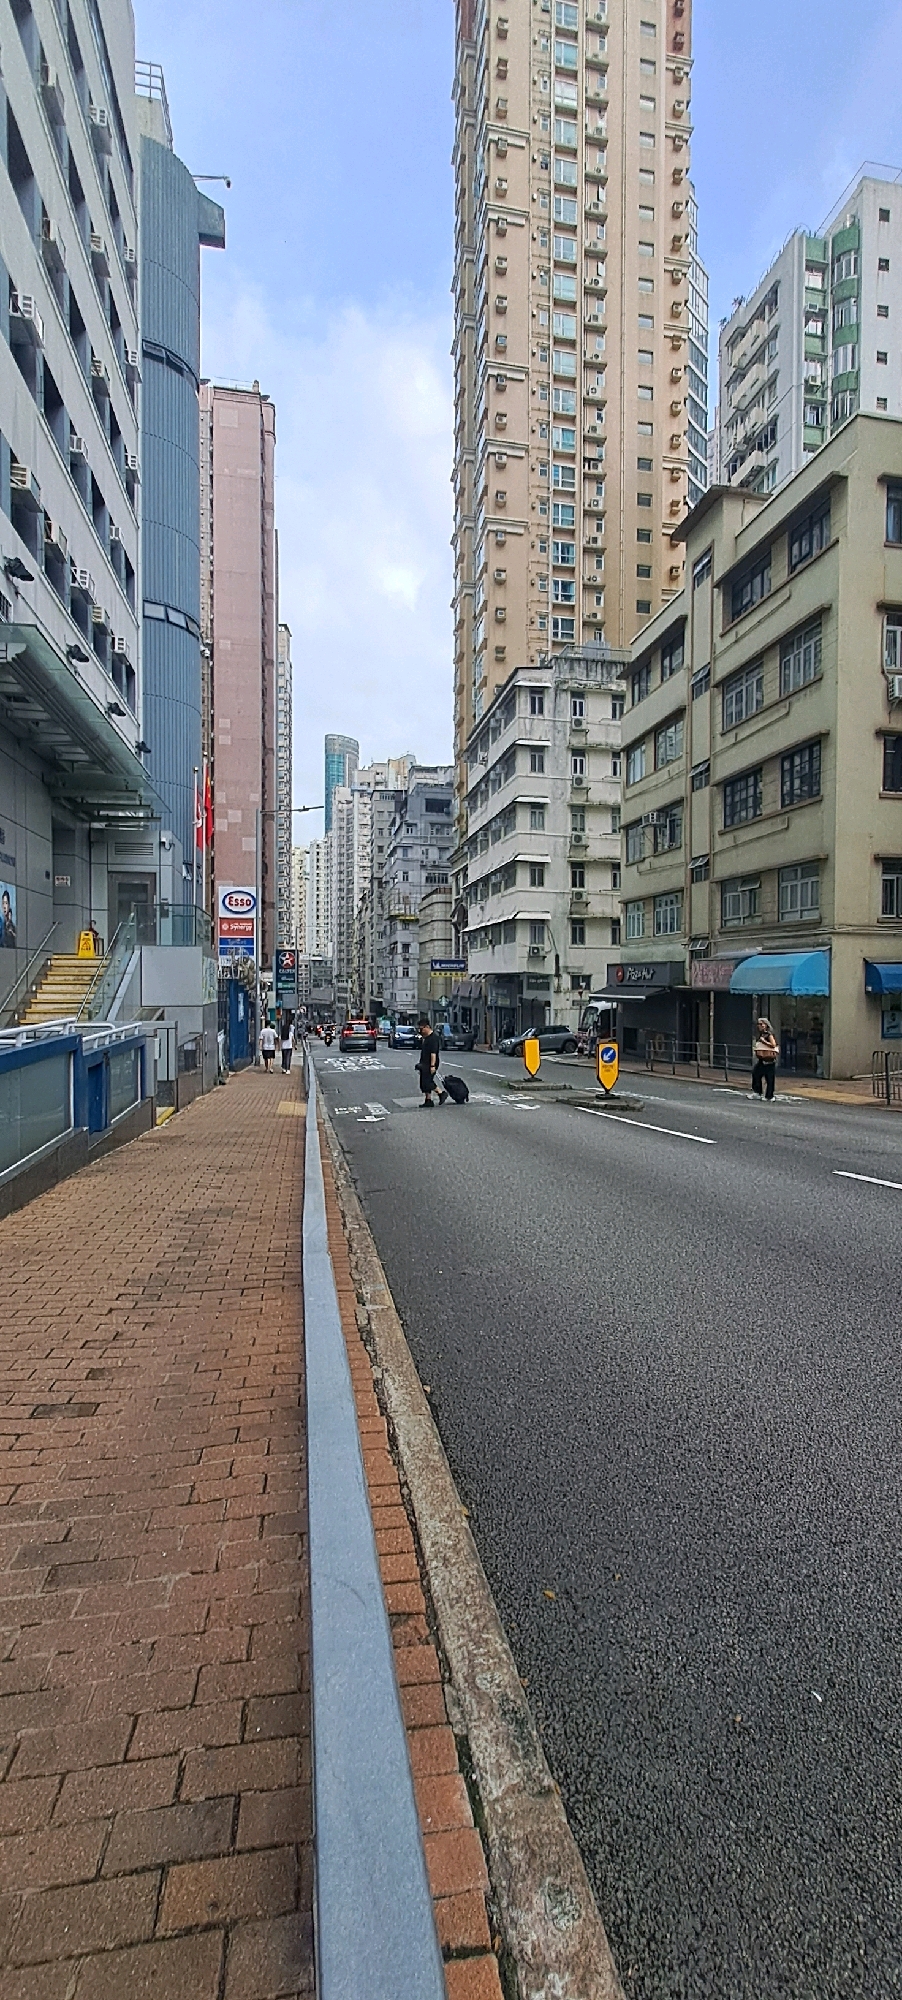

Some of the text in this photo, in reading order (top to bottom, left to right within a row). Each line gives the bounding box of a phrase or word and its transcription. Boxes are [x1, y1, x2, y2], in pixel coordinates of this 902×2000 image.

[228, 896, 252, 907] Esso
[230, 923, 253, 932] Synergy
[626, 967, 655, 981] Pizza Hut
